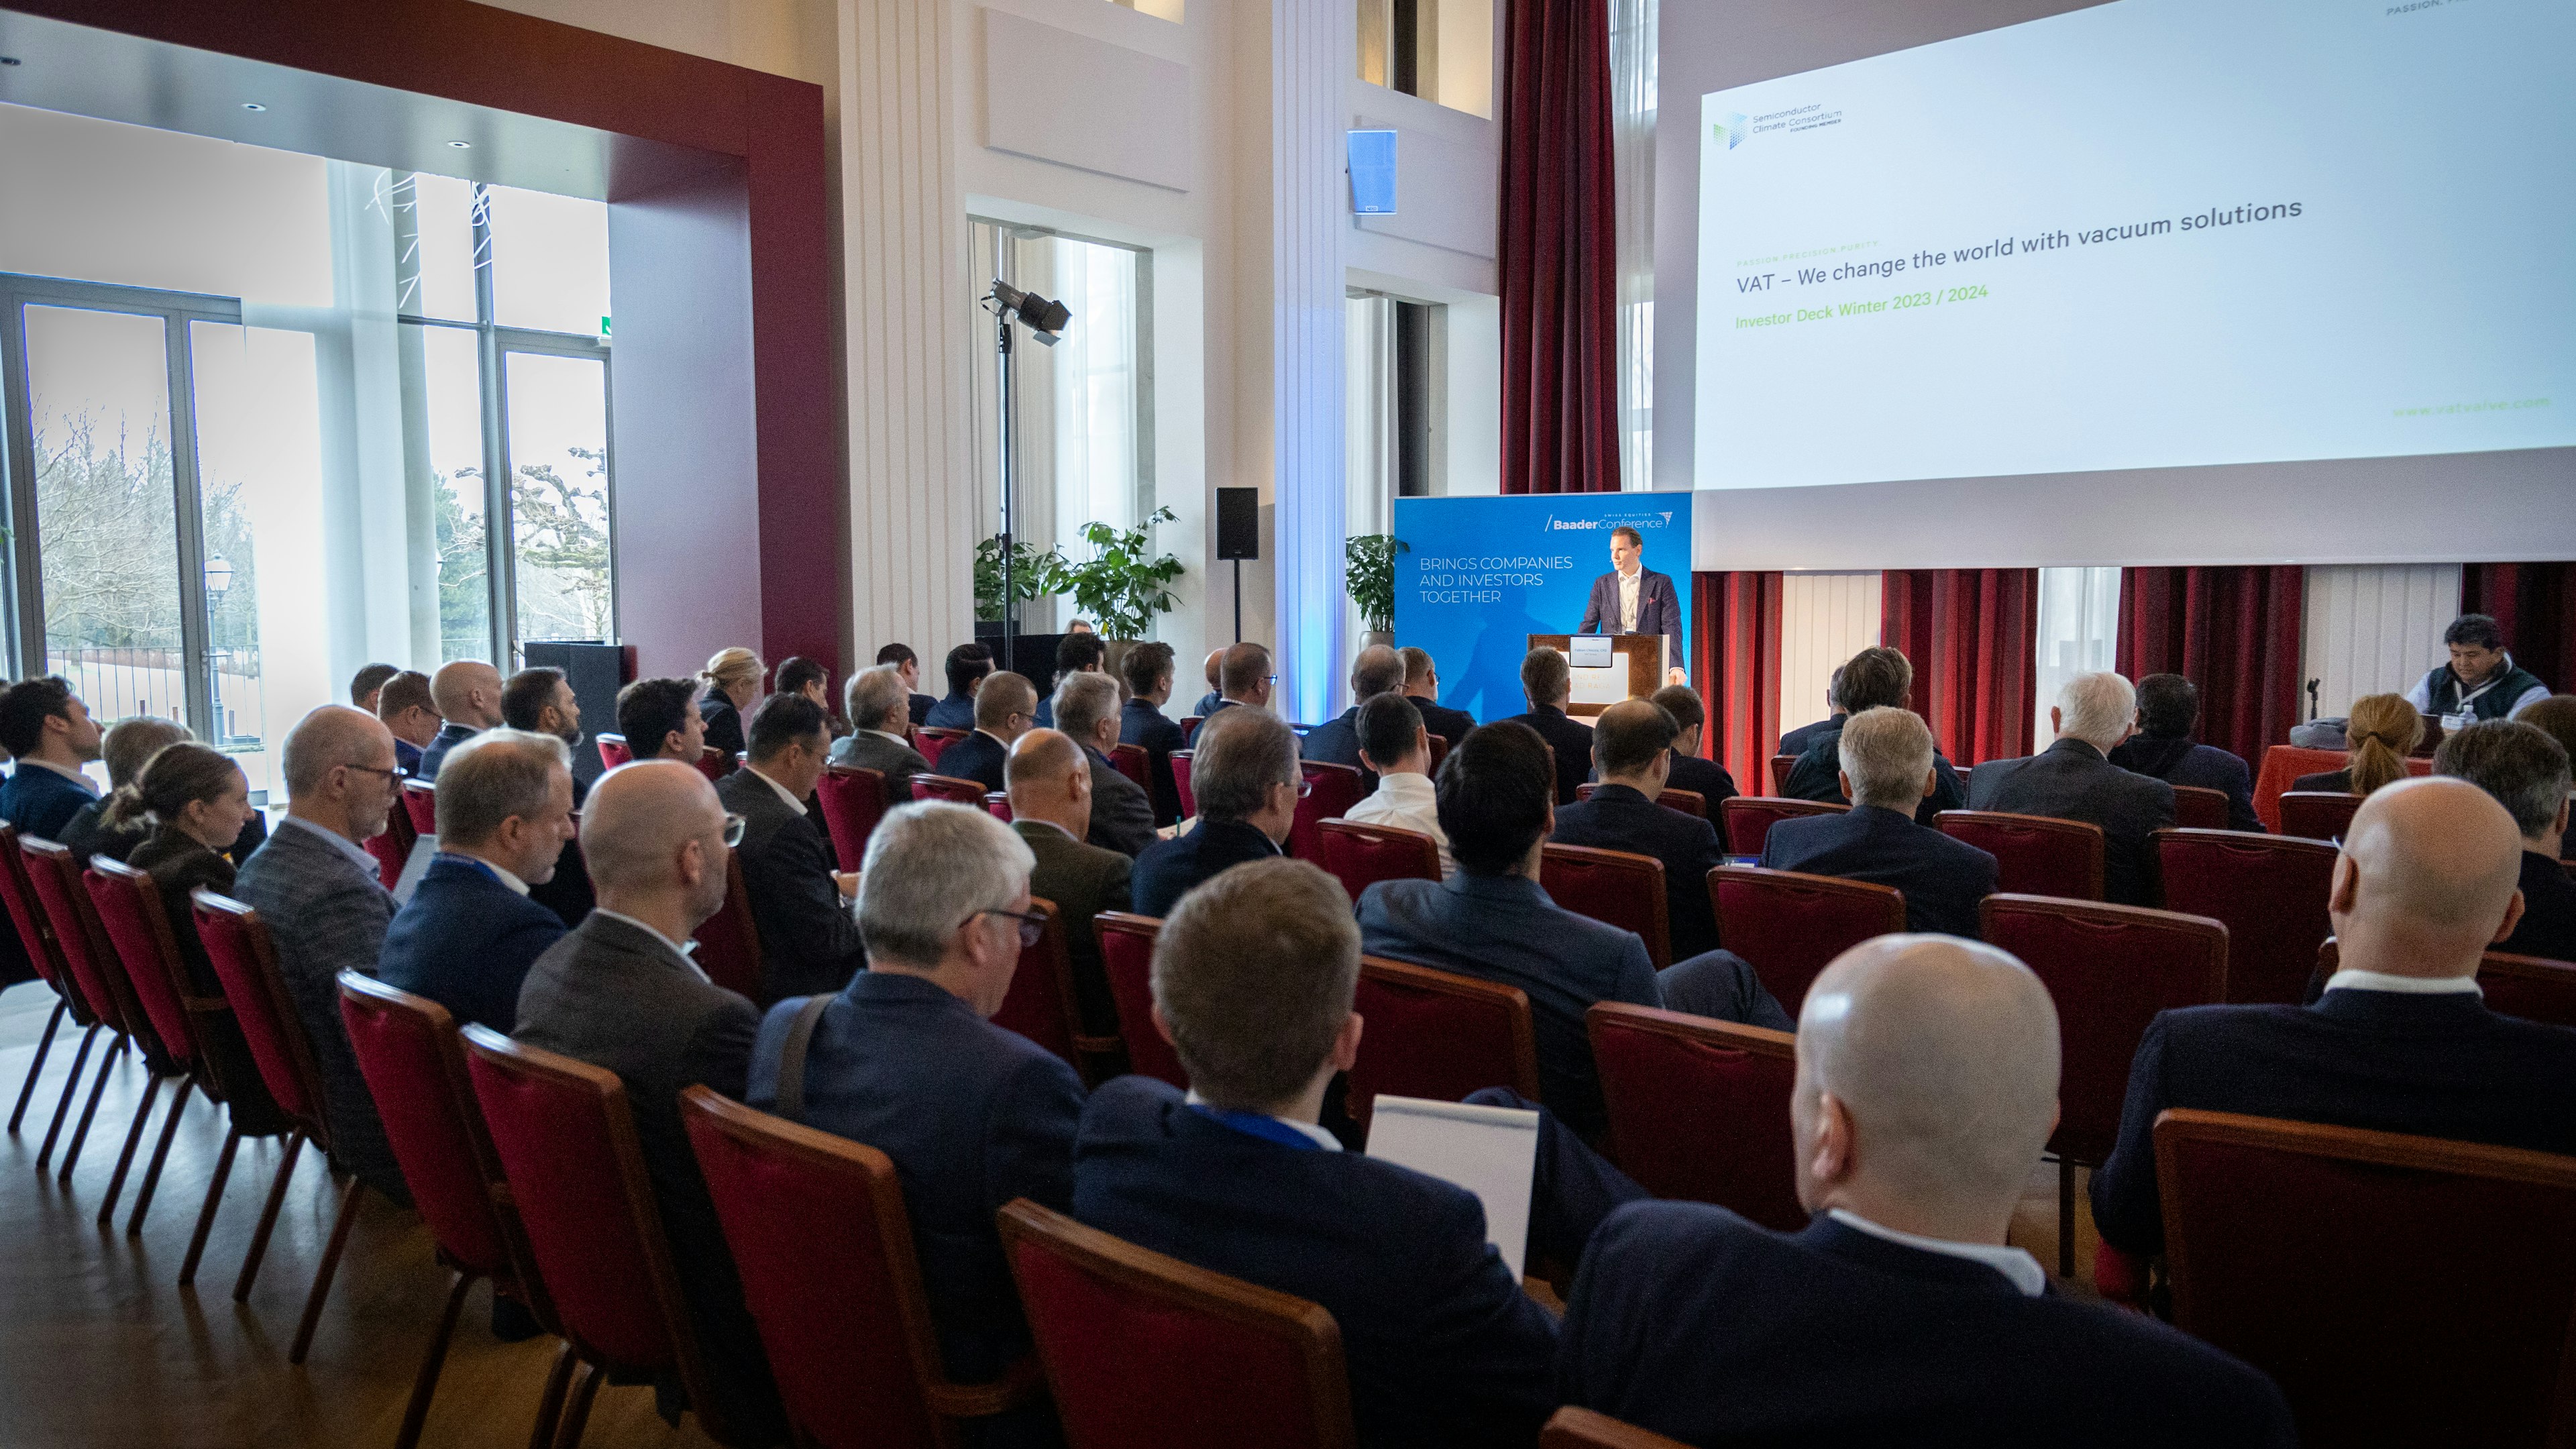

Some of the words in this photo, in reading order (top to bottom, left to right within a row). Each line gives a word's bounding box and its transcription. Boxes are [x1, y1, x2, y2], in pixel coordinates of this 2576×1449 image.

[1753, 104, 1821, 123] Semiconductor
[1753, 121, 1786, 133] Climate
[1788, 111, 1842, 126] Consortium
[1790, 124, 1818, 133] FOUNDING
[1819, 118, 1842, 127] MEMBER
[1737, 274, 1775, 293] VAT
[1798, 268, 1827, 285] We
[1833, 257, 1906, 280] change
[1913, 250, 1946, 269] the
[1953, 237, 2015, 263] world
[2021, 229, 2070, 253] with
[2078, 219, 2171, 245] vacuum
[2180, 201, 2303, 231] solutions
[1735, 311, 1792, 329] Investor
[1797, 305, 1833, 323] Deck
[1838, 299, 1888, 317] Winter
[1893, 291, 1931, 310] 2023
[1936, 289, 1944, 305] /
[1948, 284, 1989, 303] 2024
[1420, 557, 1477, 570] BRINGS
[1480, 555, 1573, 570] COMPANIES
[1419, 574, 1454, 587] AND
[1458, 573, 1543, 586] INVESTORS
[1419, 590, 1501, 603] TOGETHER
